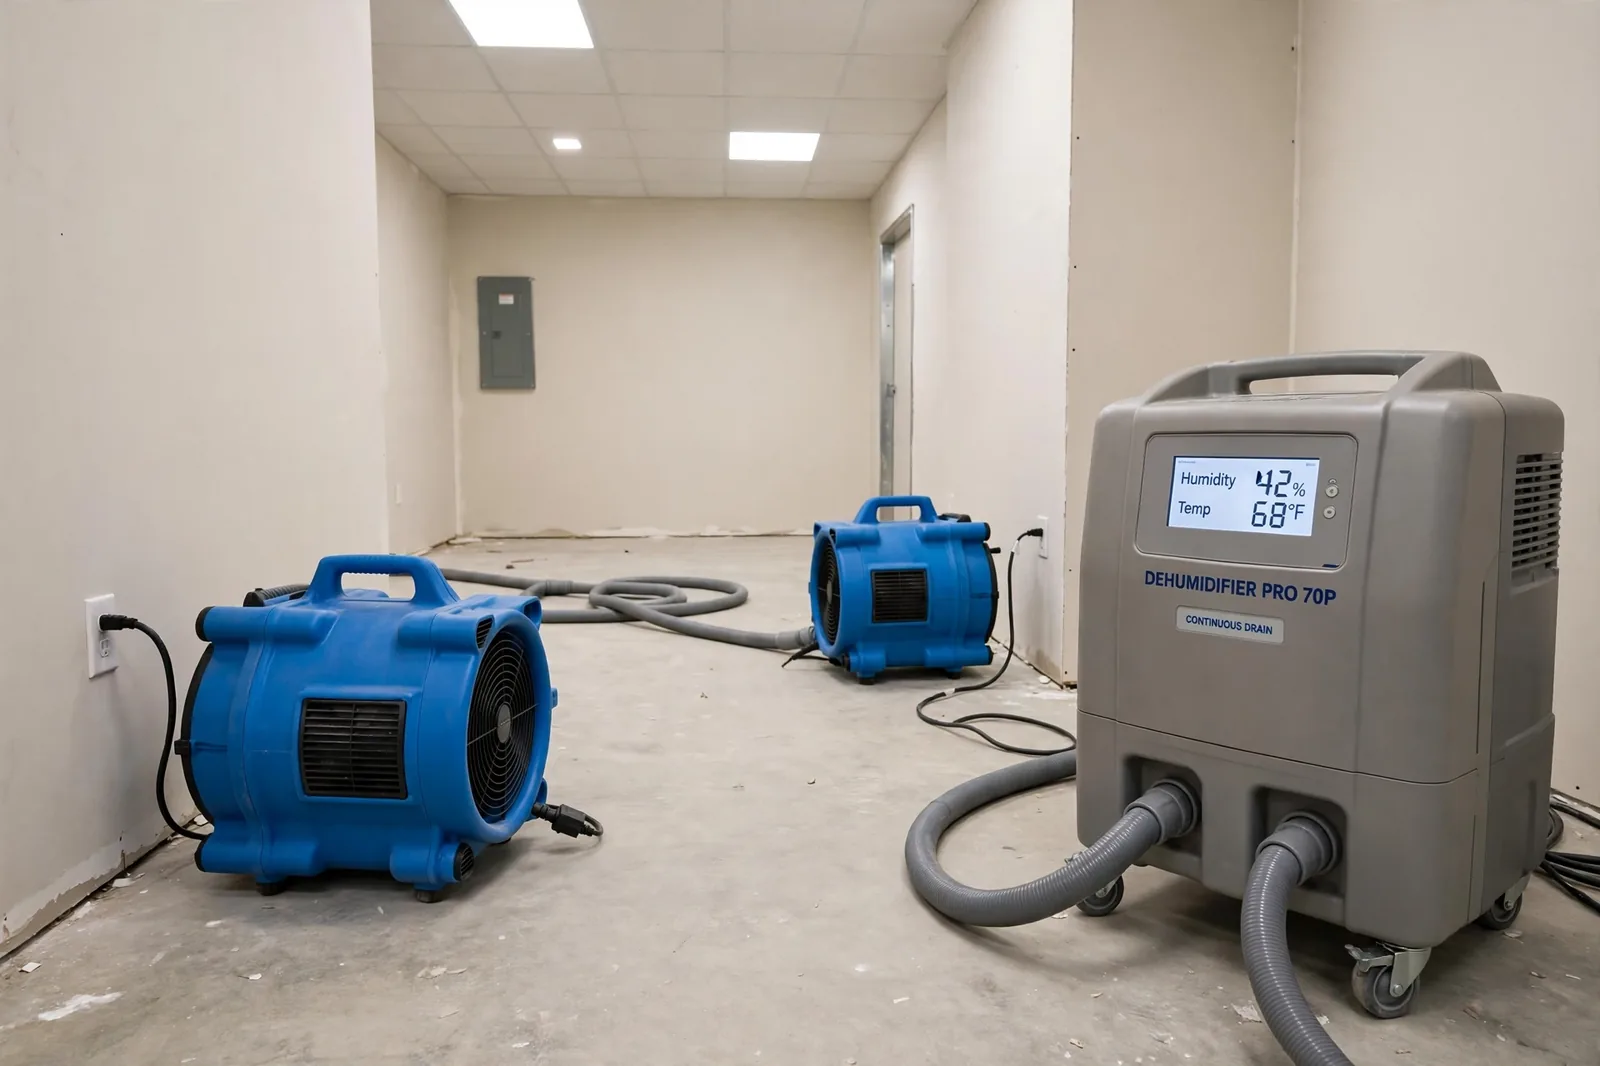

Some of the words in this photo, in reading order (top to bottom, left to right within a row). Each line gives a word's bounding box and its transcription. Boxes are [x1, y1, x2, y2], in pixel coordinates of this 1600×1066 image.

[1181, 472, 1236, 490] Humidity
[1178, 501, 1211, 518] Temp
[1145, 570, 1256, 597] DEHUMIDIFIER
[1262, 582, 1297, 601] PRO
[1303, 587, 1337, 605] 70P
[1186, 615, 1242, 631] CONTINUOUS
[1244, 623, 1273, 635] DRAIN
